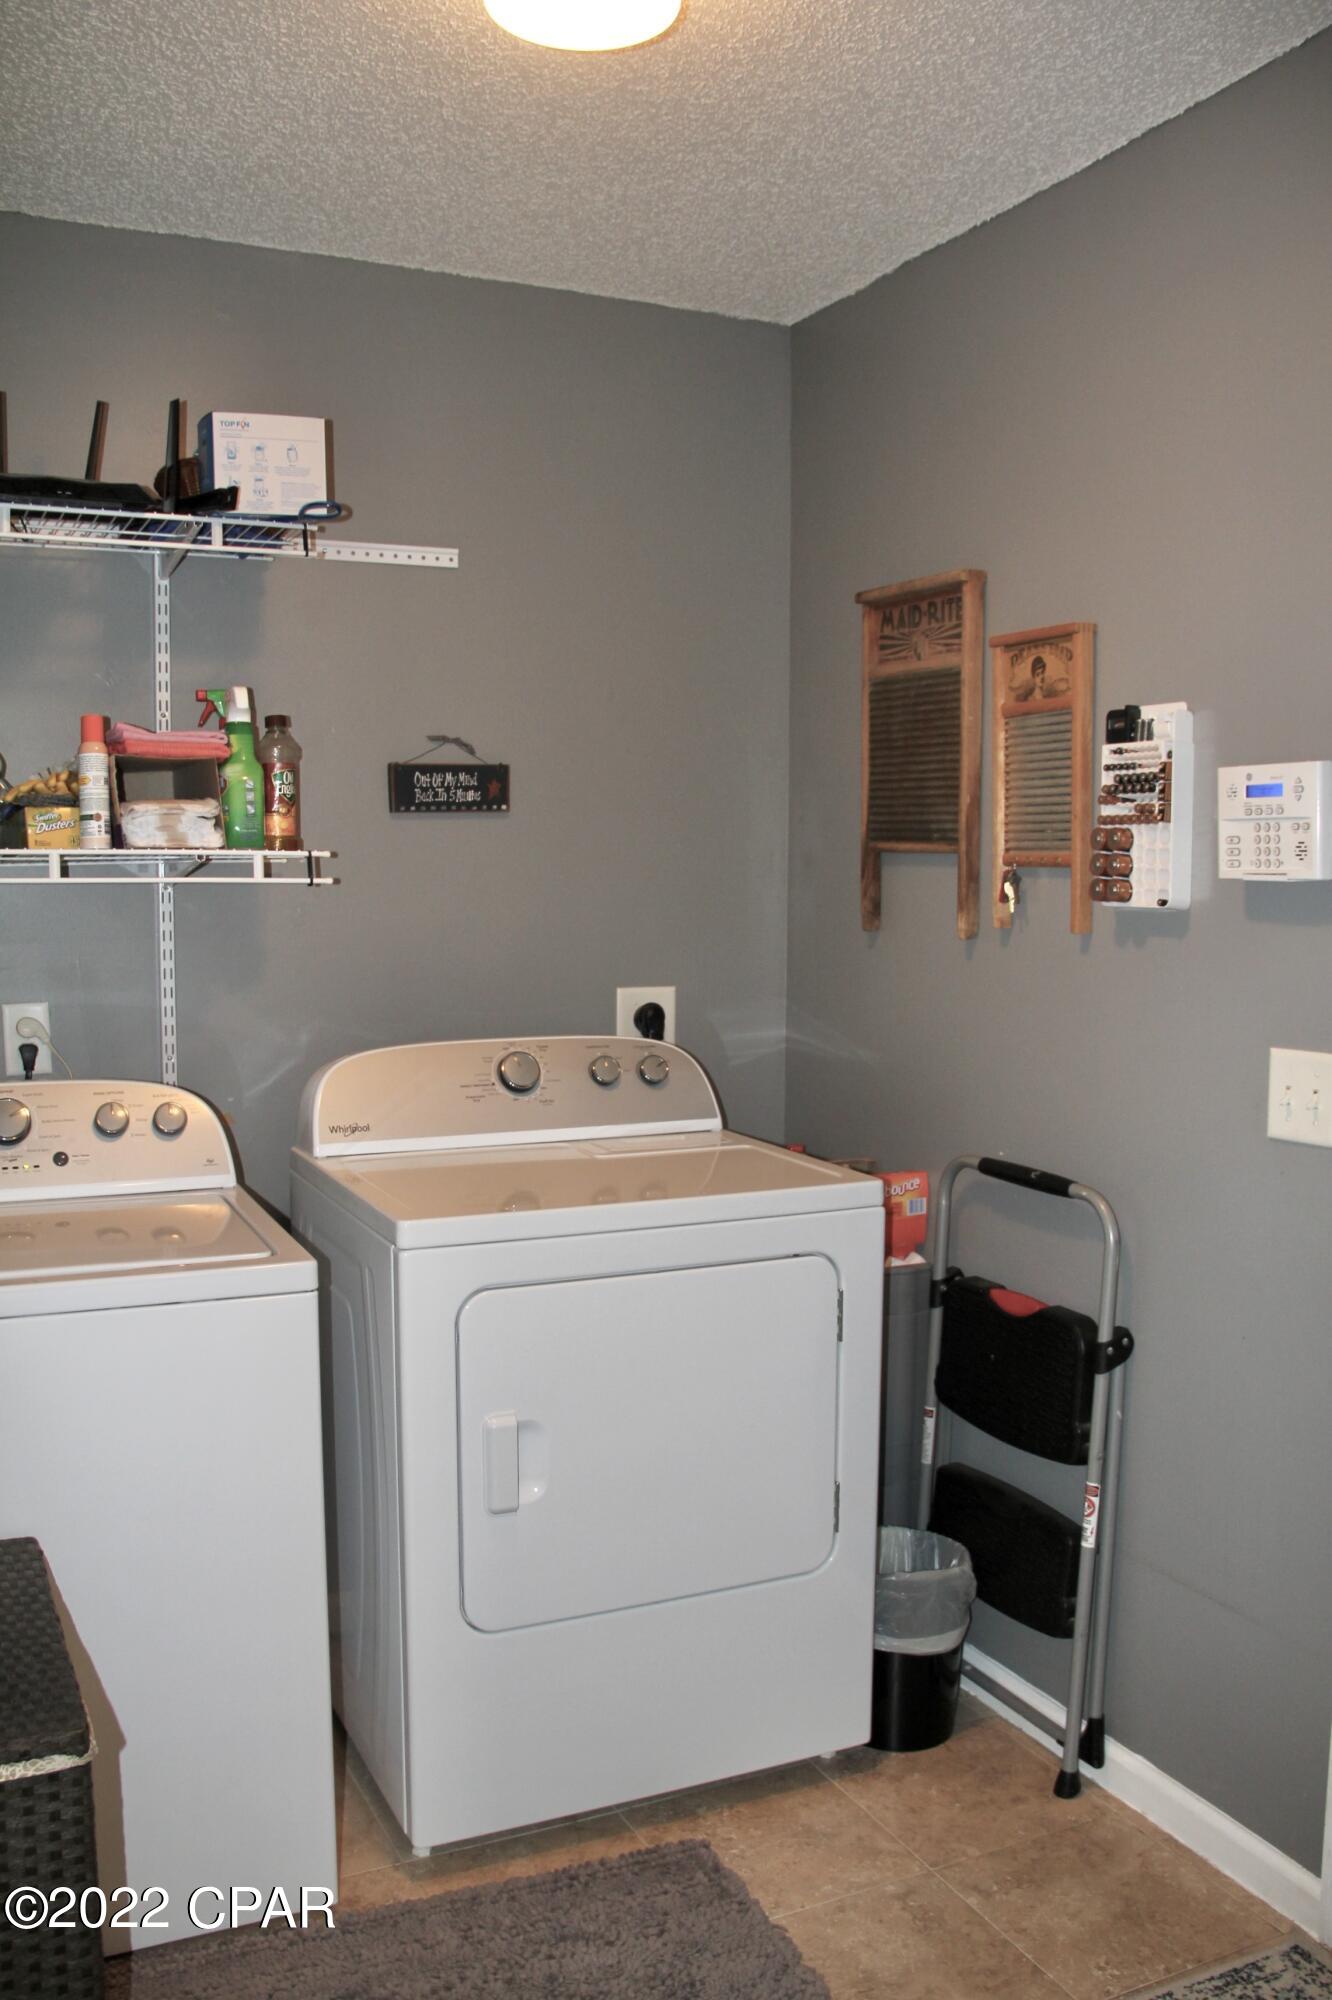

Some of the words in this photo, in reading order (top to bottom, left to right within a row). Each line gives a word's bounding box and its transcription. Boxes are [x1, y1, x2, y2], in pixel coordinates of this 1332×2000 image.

[220, 420, 236, 428] TOP
[414, 771, 431, 788] Out
[432, 771, 444, 788] Of
[444, 771, 457, 788] My
[458, 771, 478, 787] Mind
[414, 788, 434, 803] Back
[435, 788, 447, 801] In
[449, 787, 456, 802] 5
[35, 819, 75, 834] Dusters
[328, 1122, 370, 1137] Whirlpool
